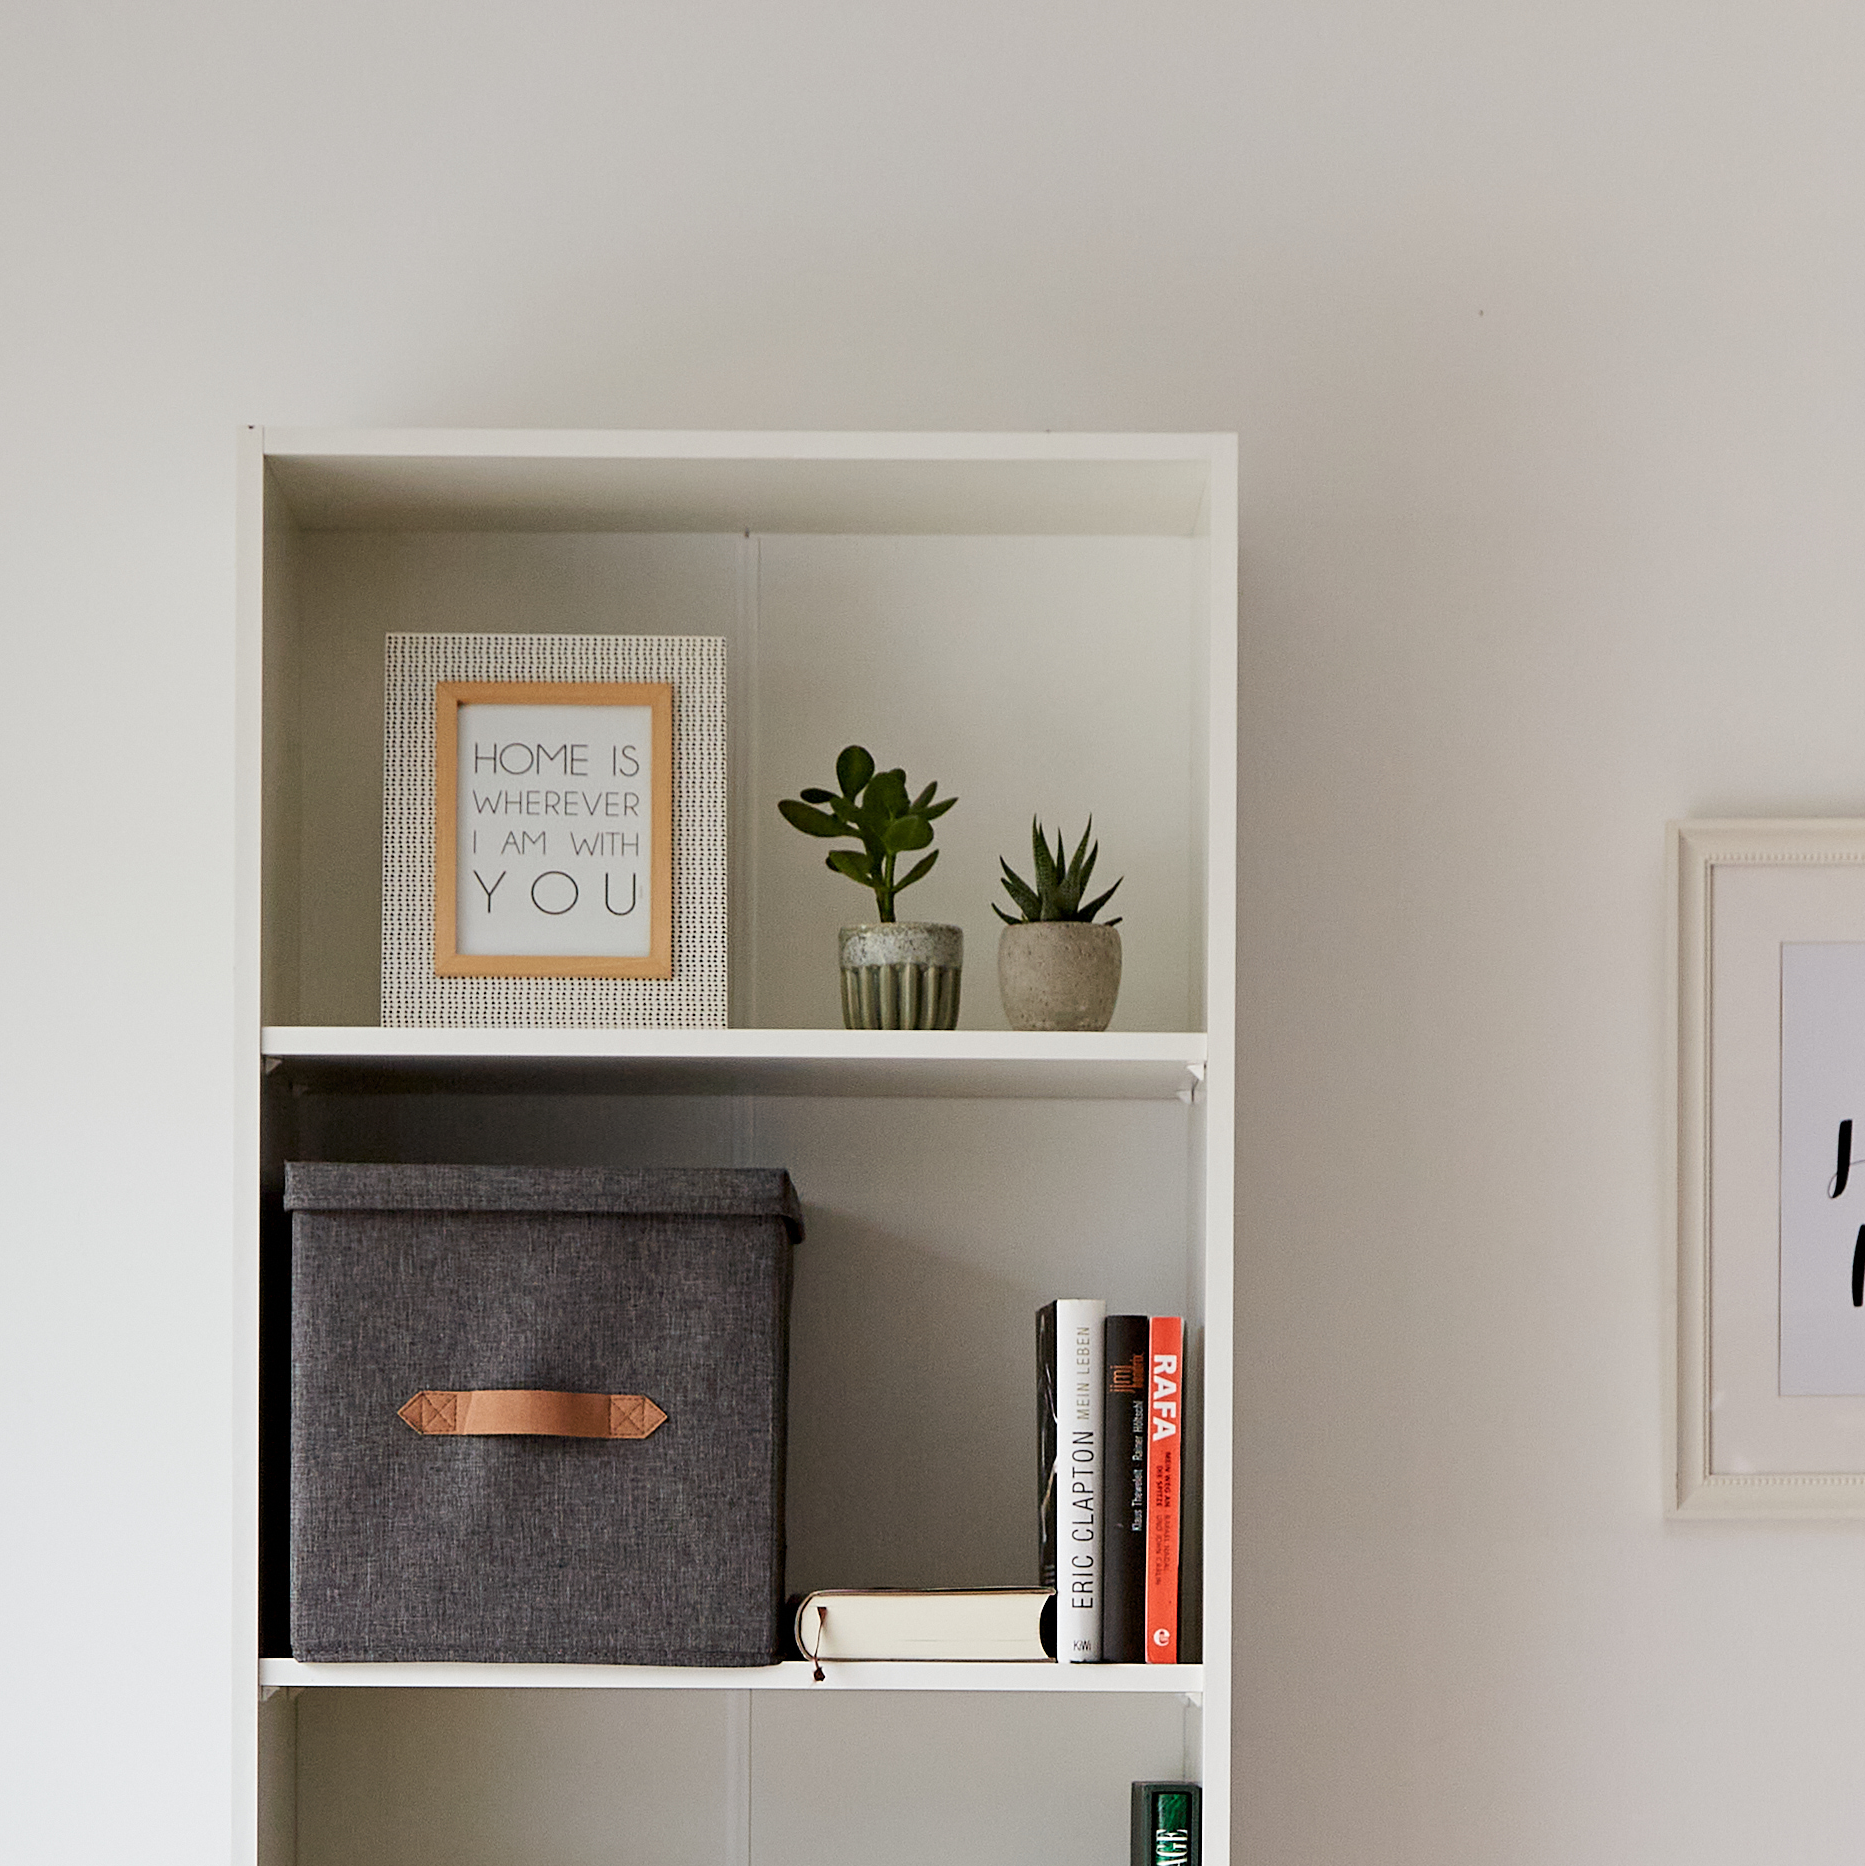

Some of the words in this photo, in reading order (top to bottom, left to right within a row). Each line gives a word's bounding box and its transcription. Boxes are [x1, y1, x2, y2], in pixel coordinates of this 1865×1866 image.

[474, 742, 588, 777] HOME
[612, 744, 641, 778] IS
[472, 789, 640, 817] WHEREVER
[472, 829, 478, 855] I
[501, 830, 547, 856] AM
[570, 831, 640, 858] WITH
[473, 869, 637, 917] YOU
[1077, 1327, 1090, 1375] LEBEN
[1077, 1382, 1090, 1420] MEIN
[1152, 1354, 1178, 1442] RAFA
[1164, 1451, 1172, 1474] MEIN
[1072, 1431, 1095, 1542] CLAPTON
[1164, 1496, 1171, 1508] AN
[1072, 1555, 1094, 1609] ERIC
